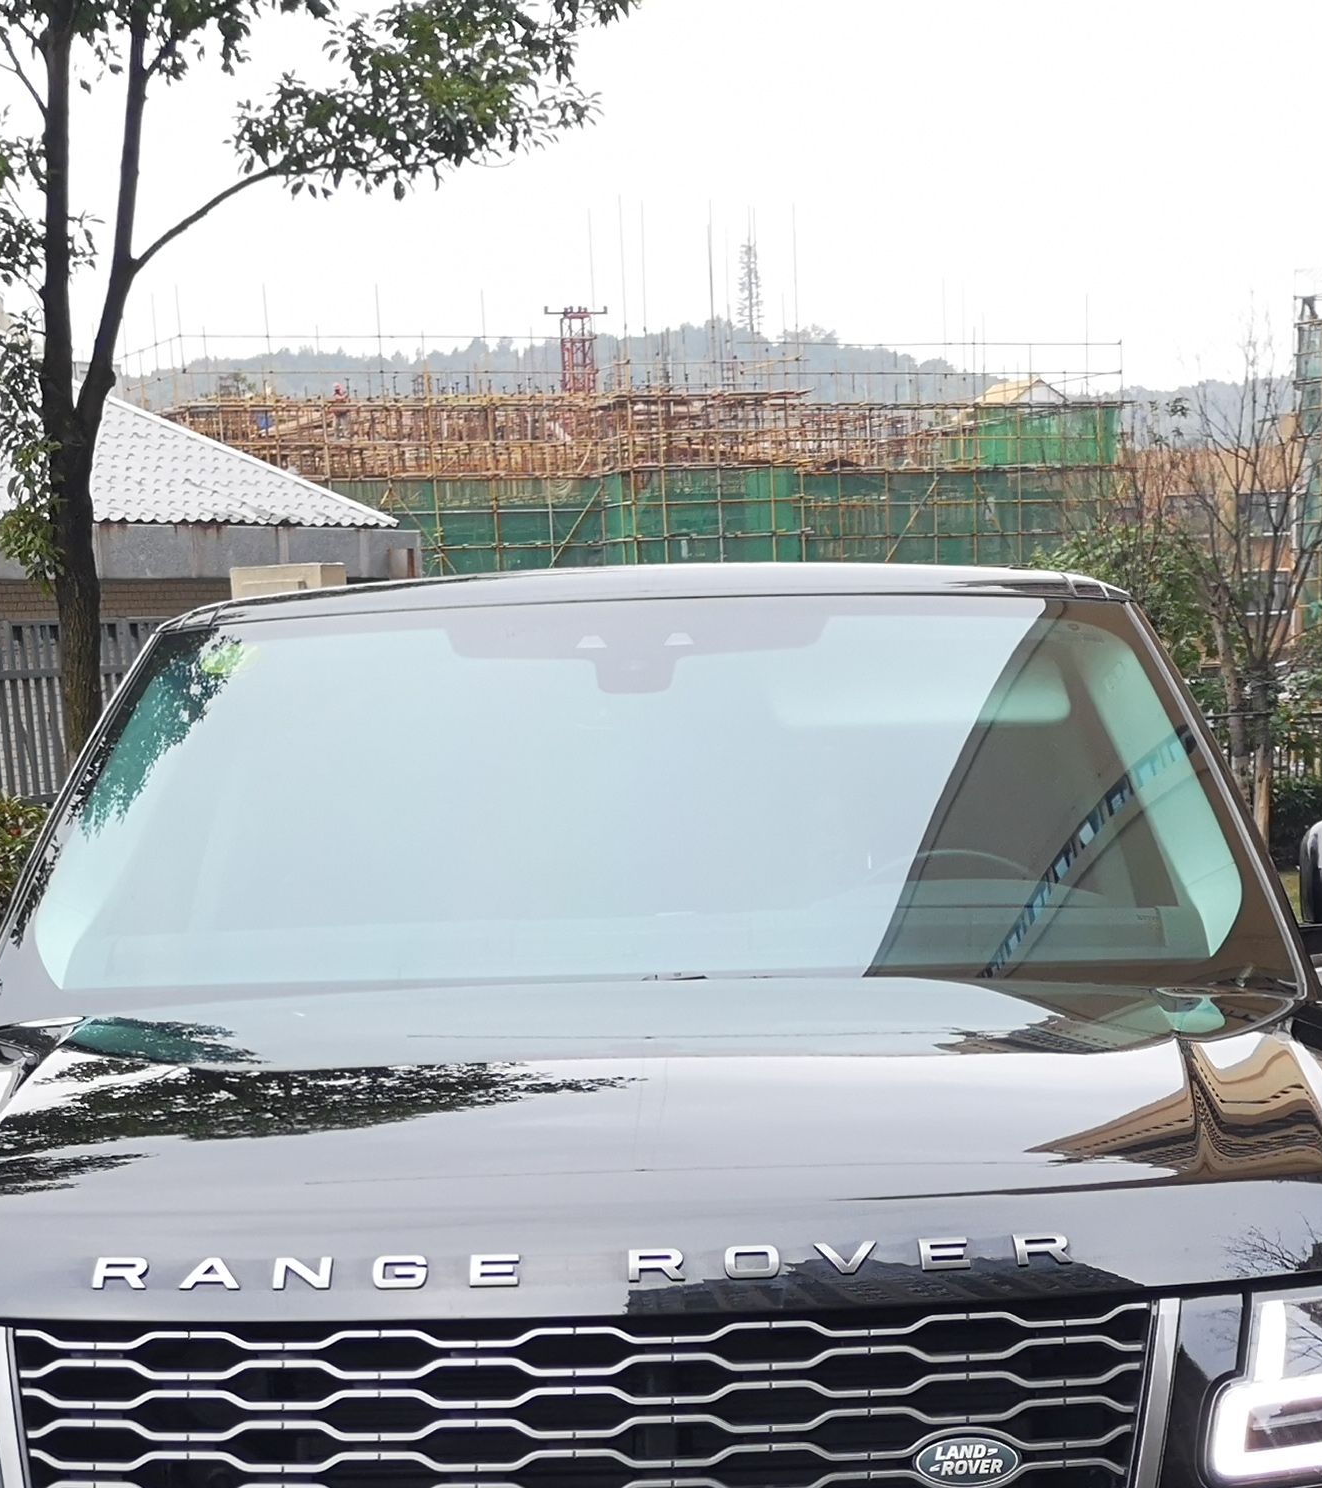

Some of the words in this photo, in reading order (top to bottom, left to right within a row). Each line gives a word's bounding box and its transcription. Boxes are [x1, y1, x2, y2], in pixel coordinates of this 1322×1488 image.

[91, 1254, 521, 1291] RANGE
[627, 1231, 1075, 1283] ROVER
[934, 1444, 987, 1461] LAND
[940, 1459, 1004, 1476] ROVER
